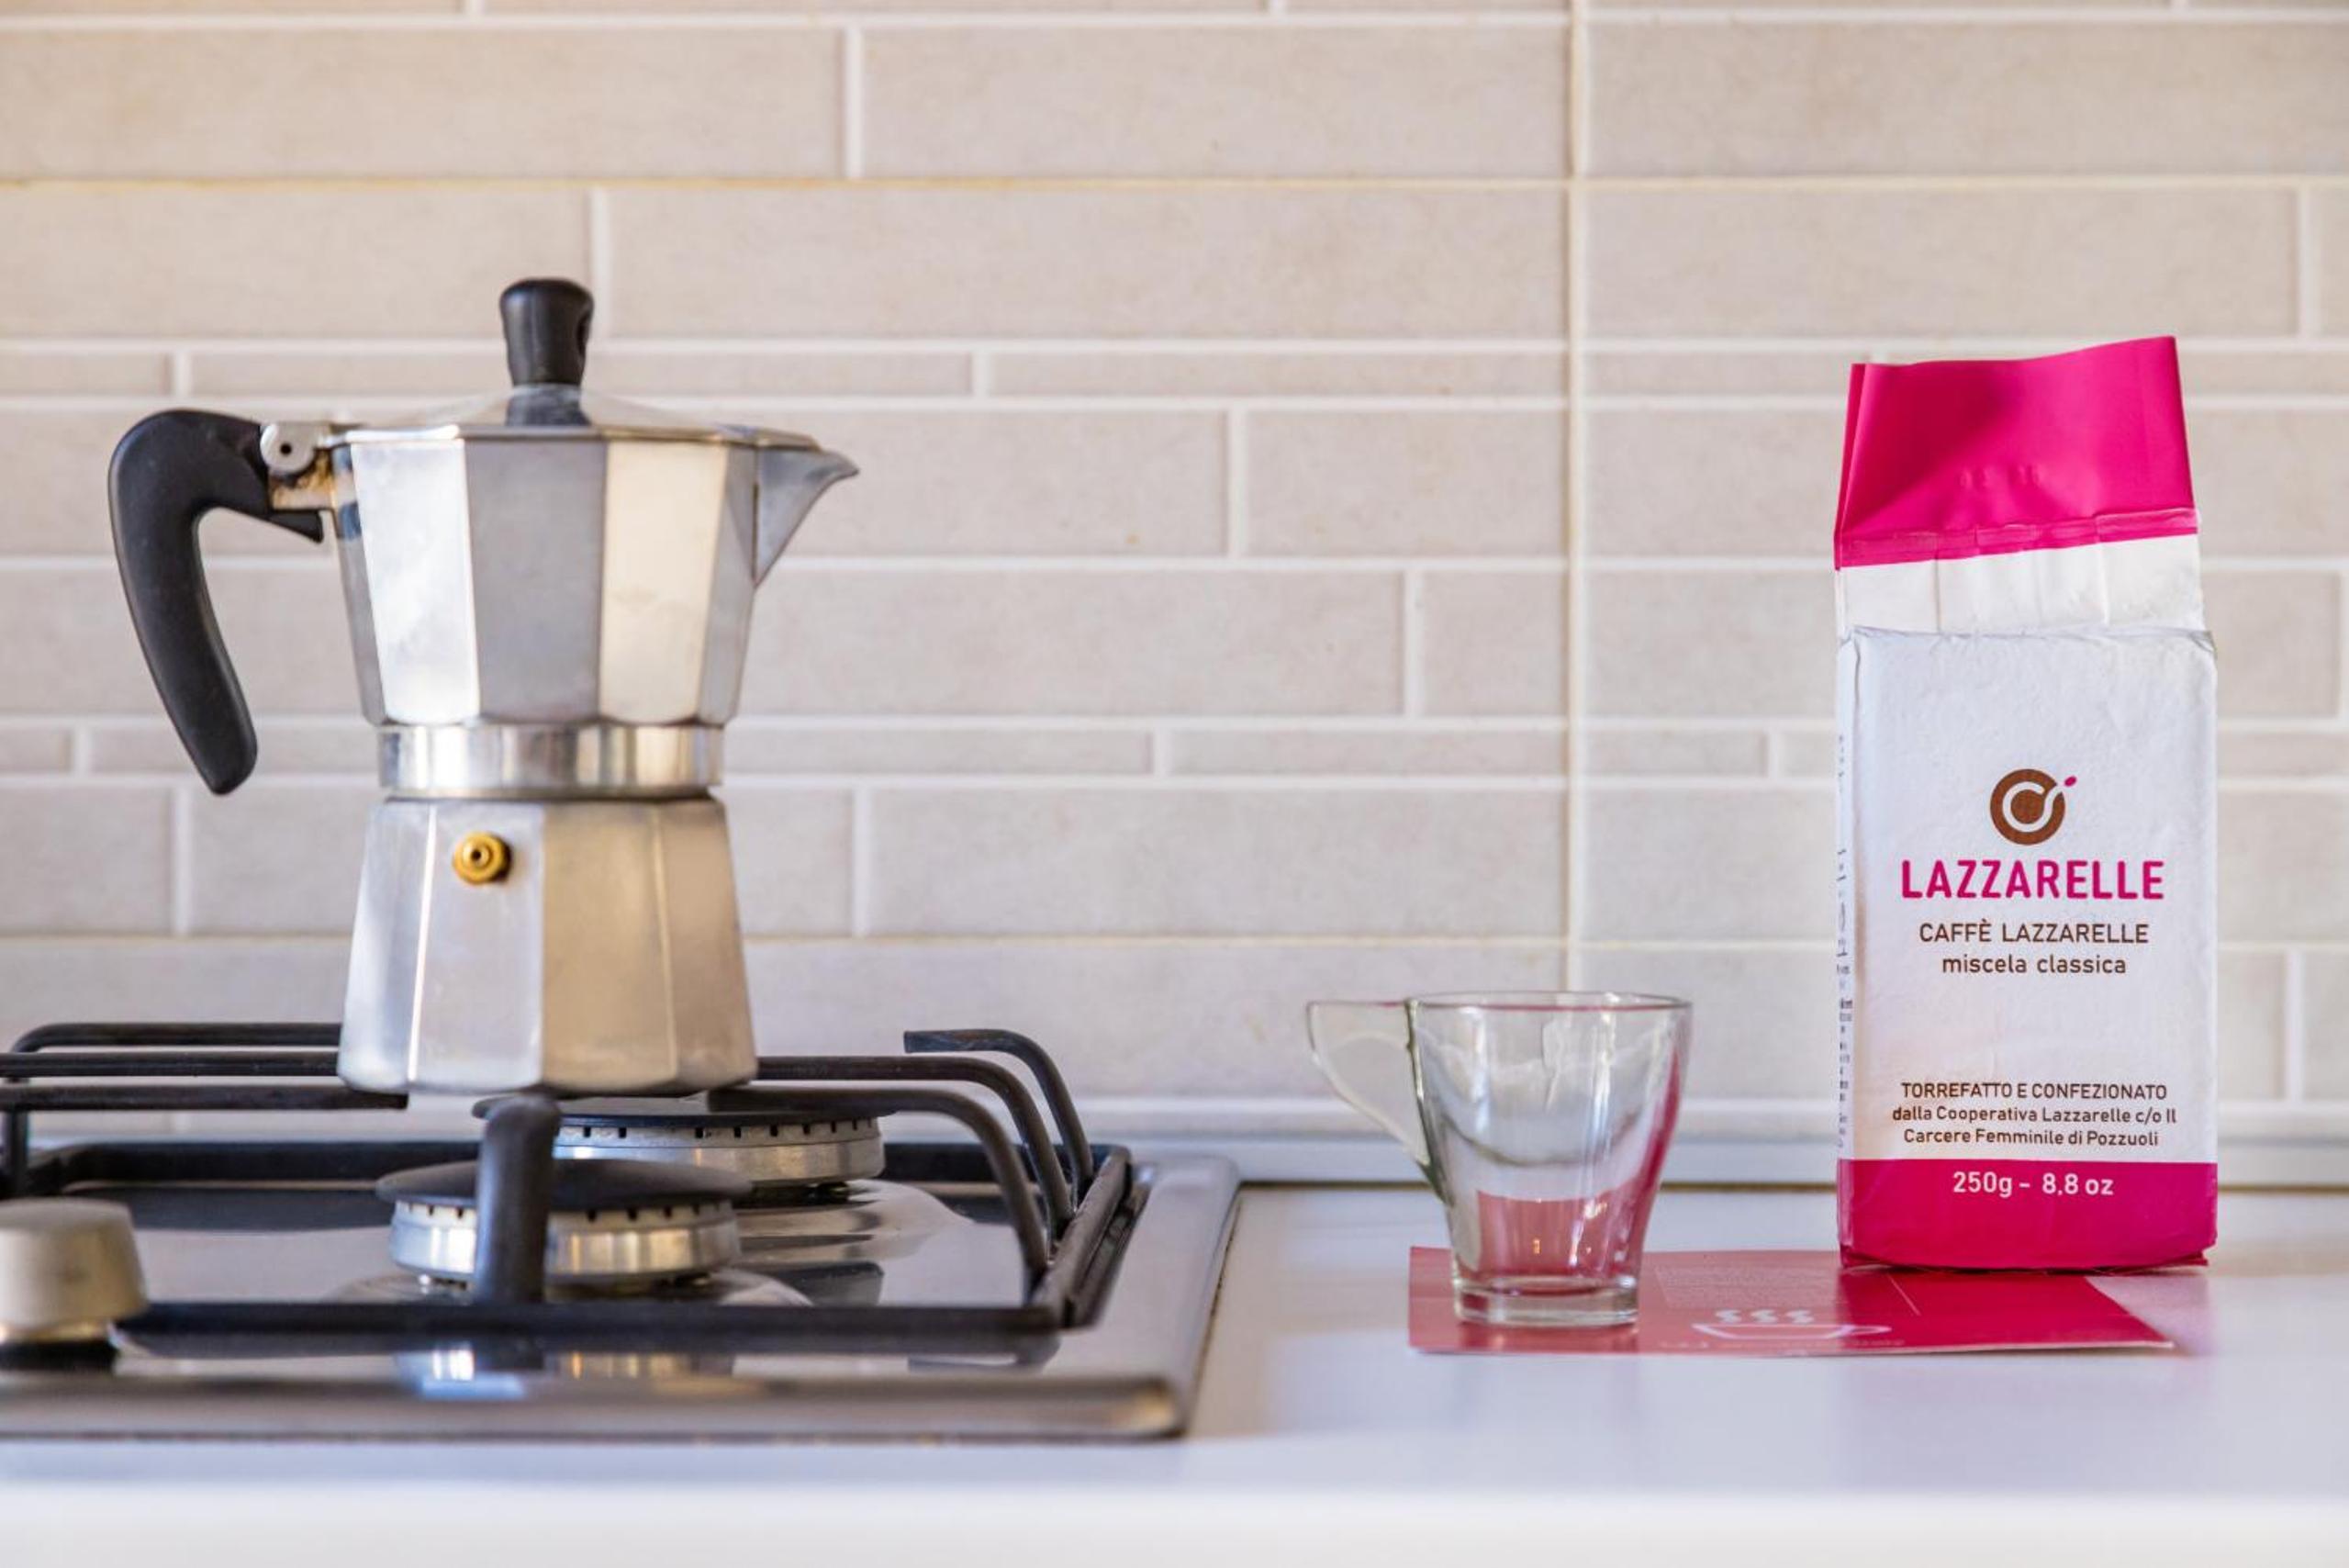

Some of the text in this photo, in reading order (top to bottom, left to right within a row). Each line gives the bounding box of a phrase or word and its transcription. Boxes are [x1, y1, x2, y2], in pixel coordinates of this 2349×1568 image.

[1901, 859, 2164, 901] LAZZARELLE
[1919, 918, 2149, 944] CAFFÈ LAZZARELLE
[1942, 953, 2126, 974] miscela classica
[1901, 1081, 2167, 1101] TORREFATTO E CONFEZIONATO
[1892, 1105, 1932, 1122] dalla
[1936, 1105, 2038, 1124] Cooperativa
[2041, 1107, 2131, 1123] Lazzarelle
[2135, 1106, 2162, 1126] c/o
[1904, 1127, 2158, 1147] Carcere Femminile di Pozzuoli
[1952, 1170, 2013, 1198] 250g
[2085, 1179, 2114, 1196] oz
